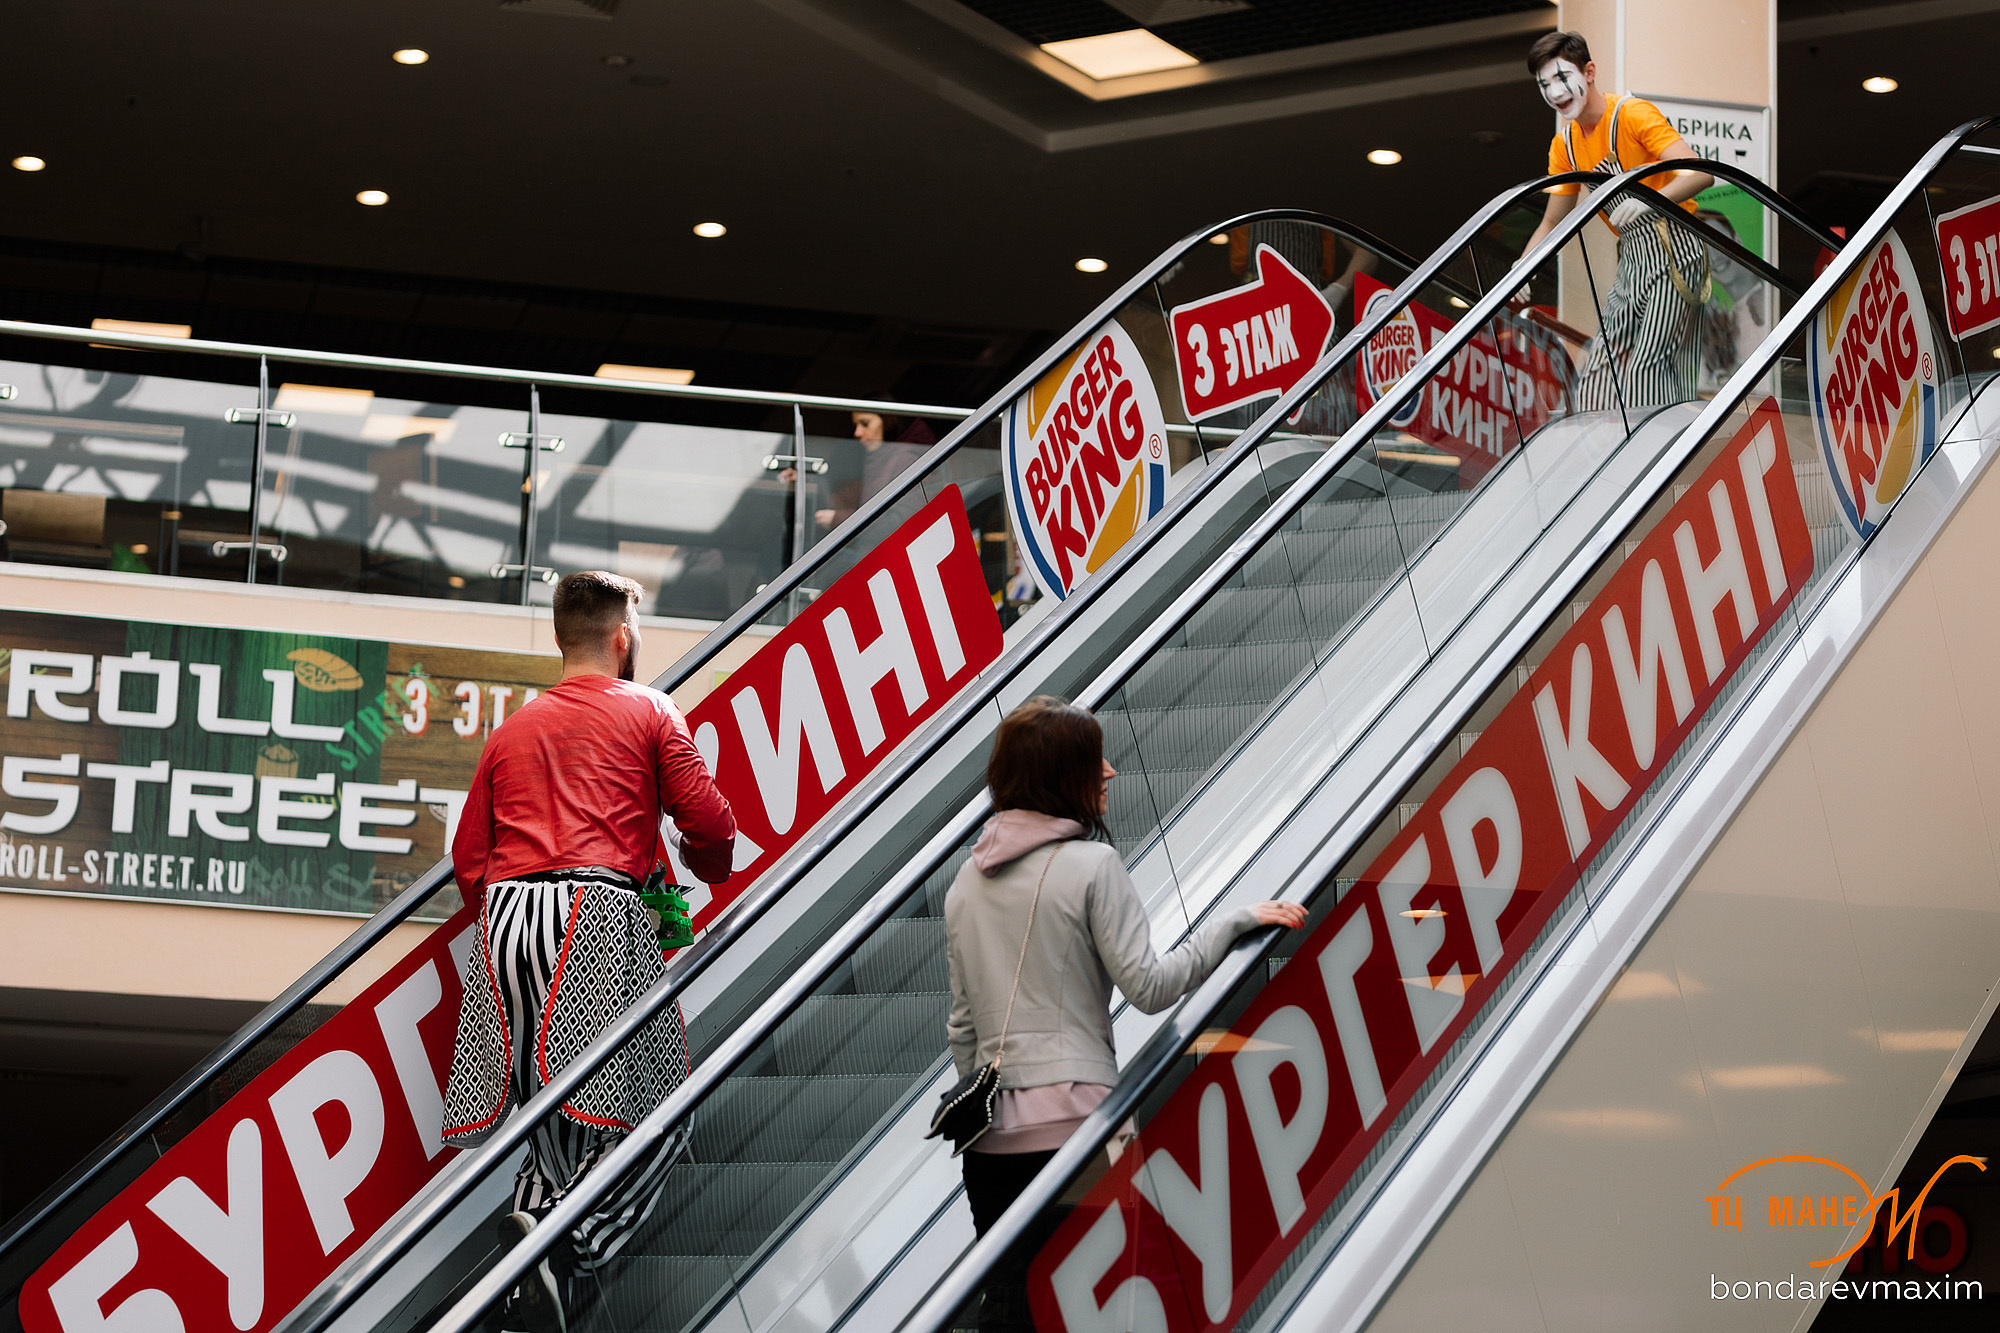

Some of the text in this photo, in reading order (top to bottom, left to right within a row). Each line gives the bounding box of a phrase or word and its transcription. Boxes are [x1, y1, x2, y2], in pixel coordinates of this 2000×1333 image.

[1691, 143, 1720, 162] ВИ
[1950, 231, 2000, 315] 3 ЭТ
[1187, 303, 1300, 397] 3 ЭТАЖ
[1370, 325, 1415, 351] BURGER
[1371, 348, 1417, 386] KING
[1825, 242, 1900, 448] BURGER
[1025, 334, 1122, 526] BURGER
[1432, 379, 1510, 458] КИНГ
[1843, 291, 1919, 524] KING
[1046, 379, 1145, 594] KING
[1531, 420, 1792, 865] КИНГ
[6, 649, 344, 741] ROLL
[403, 678, 430, 736] 3
[0, 844, 246, 894] ROLL-STREET.RU
[47, 922, 477, 1333] БУРГ
